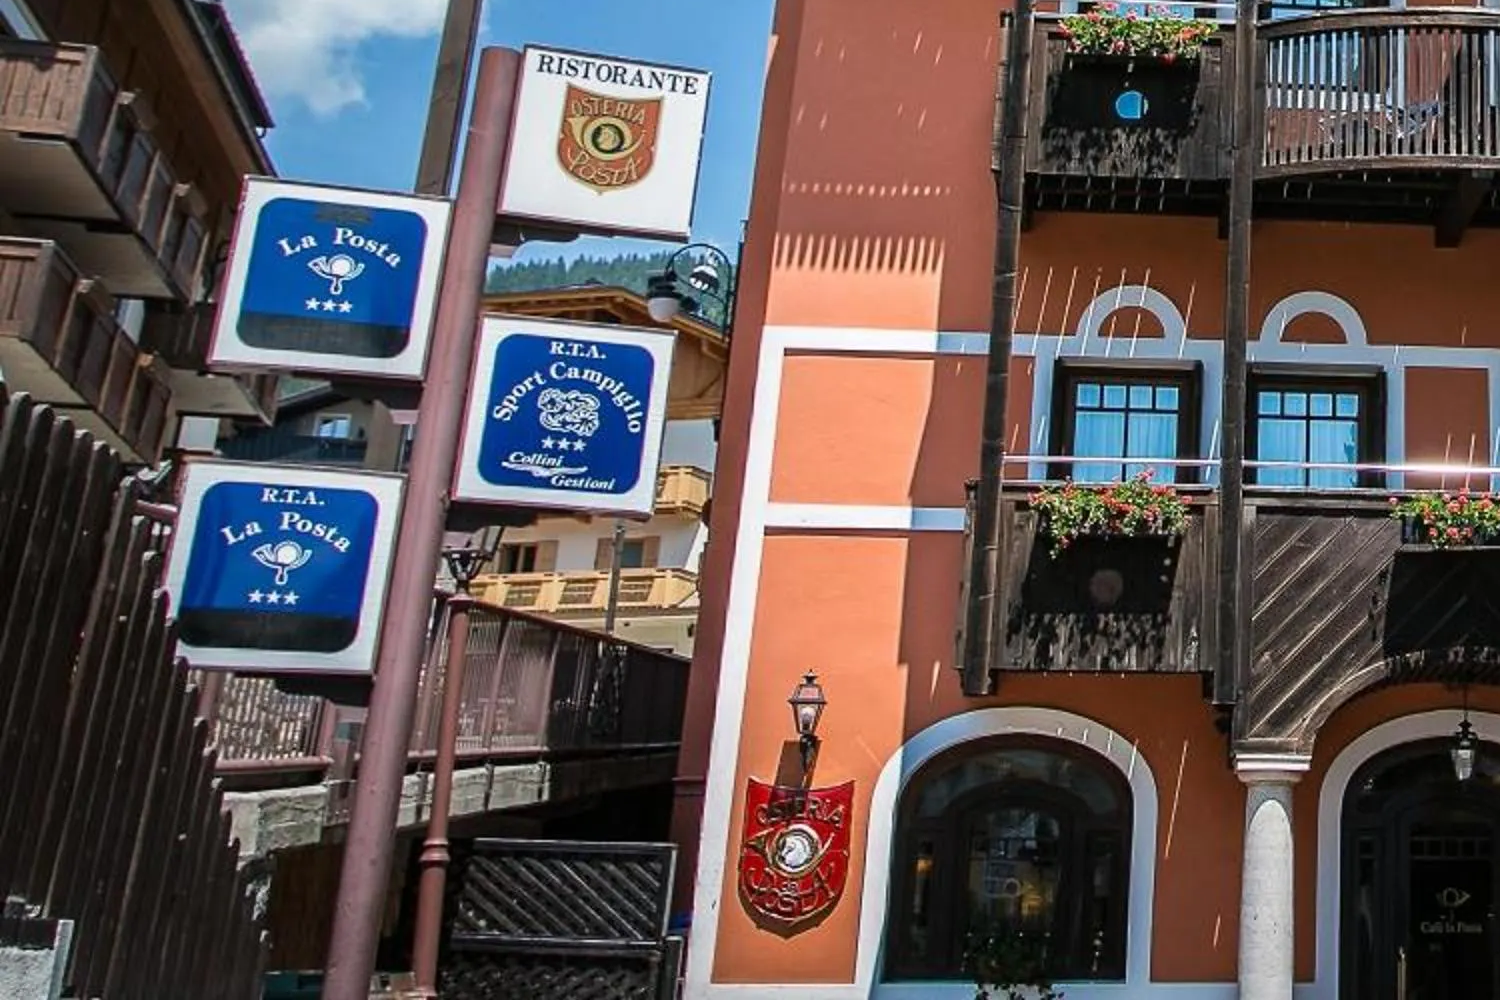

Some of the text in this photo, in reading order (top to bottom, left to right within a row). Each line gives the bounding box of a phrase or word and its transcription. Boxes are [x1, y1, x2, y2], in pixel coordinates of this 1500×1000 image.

[537, 54, 699, 95] RISTORANTE
[571, 97, 645, 125] OSTERIA
[568, 150, 641, 185] POSTA
[277, 227, 402, 268] La Posta
[550, 341, 607, 359] R.T.A.
[492, 361, 644, 433] Sport Campiglio
[508, 451, 565, 466] Collini
[261, 487, 325, 506] R.T.A.
[551, 475, 616, 491] Gestioni
[220, 511, 351, 553] La Posta
